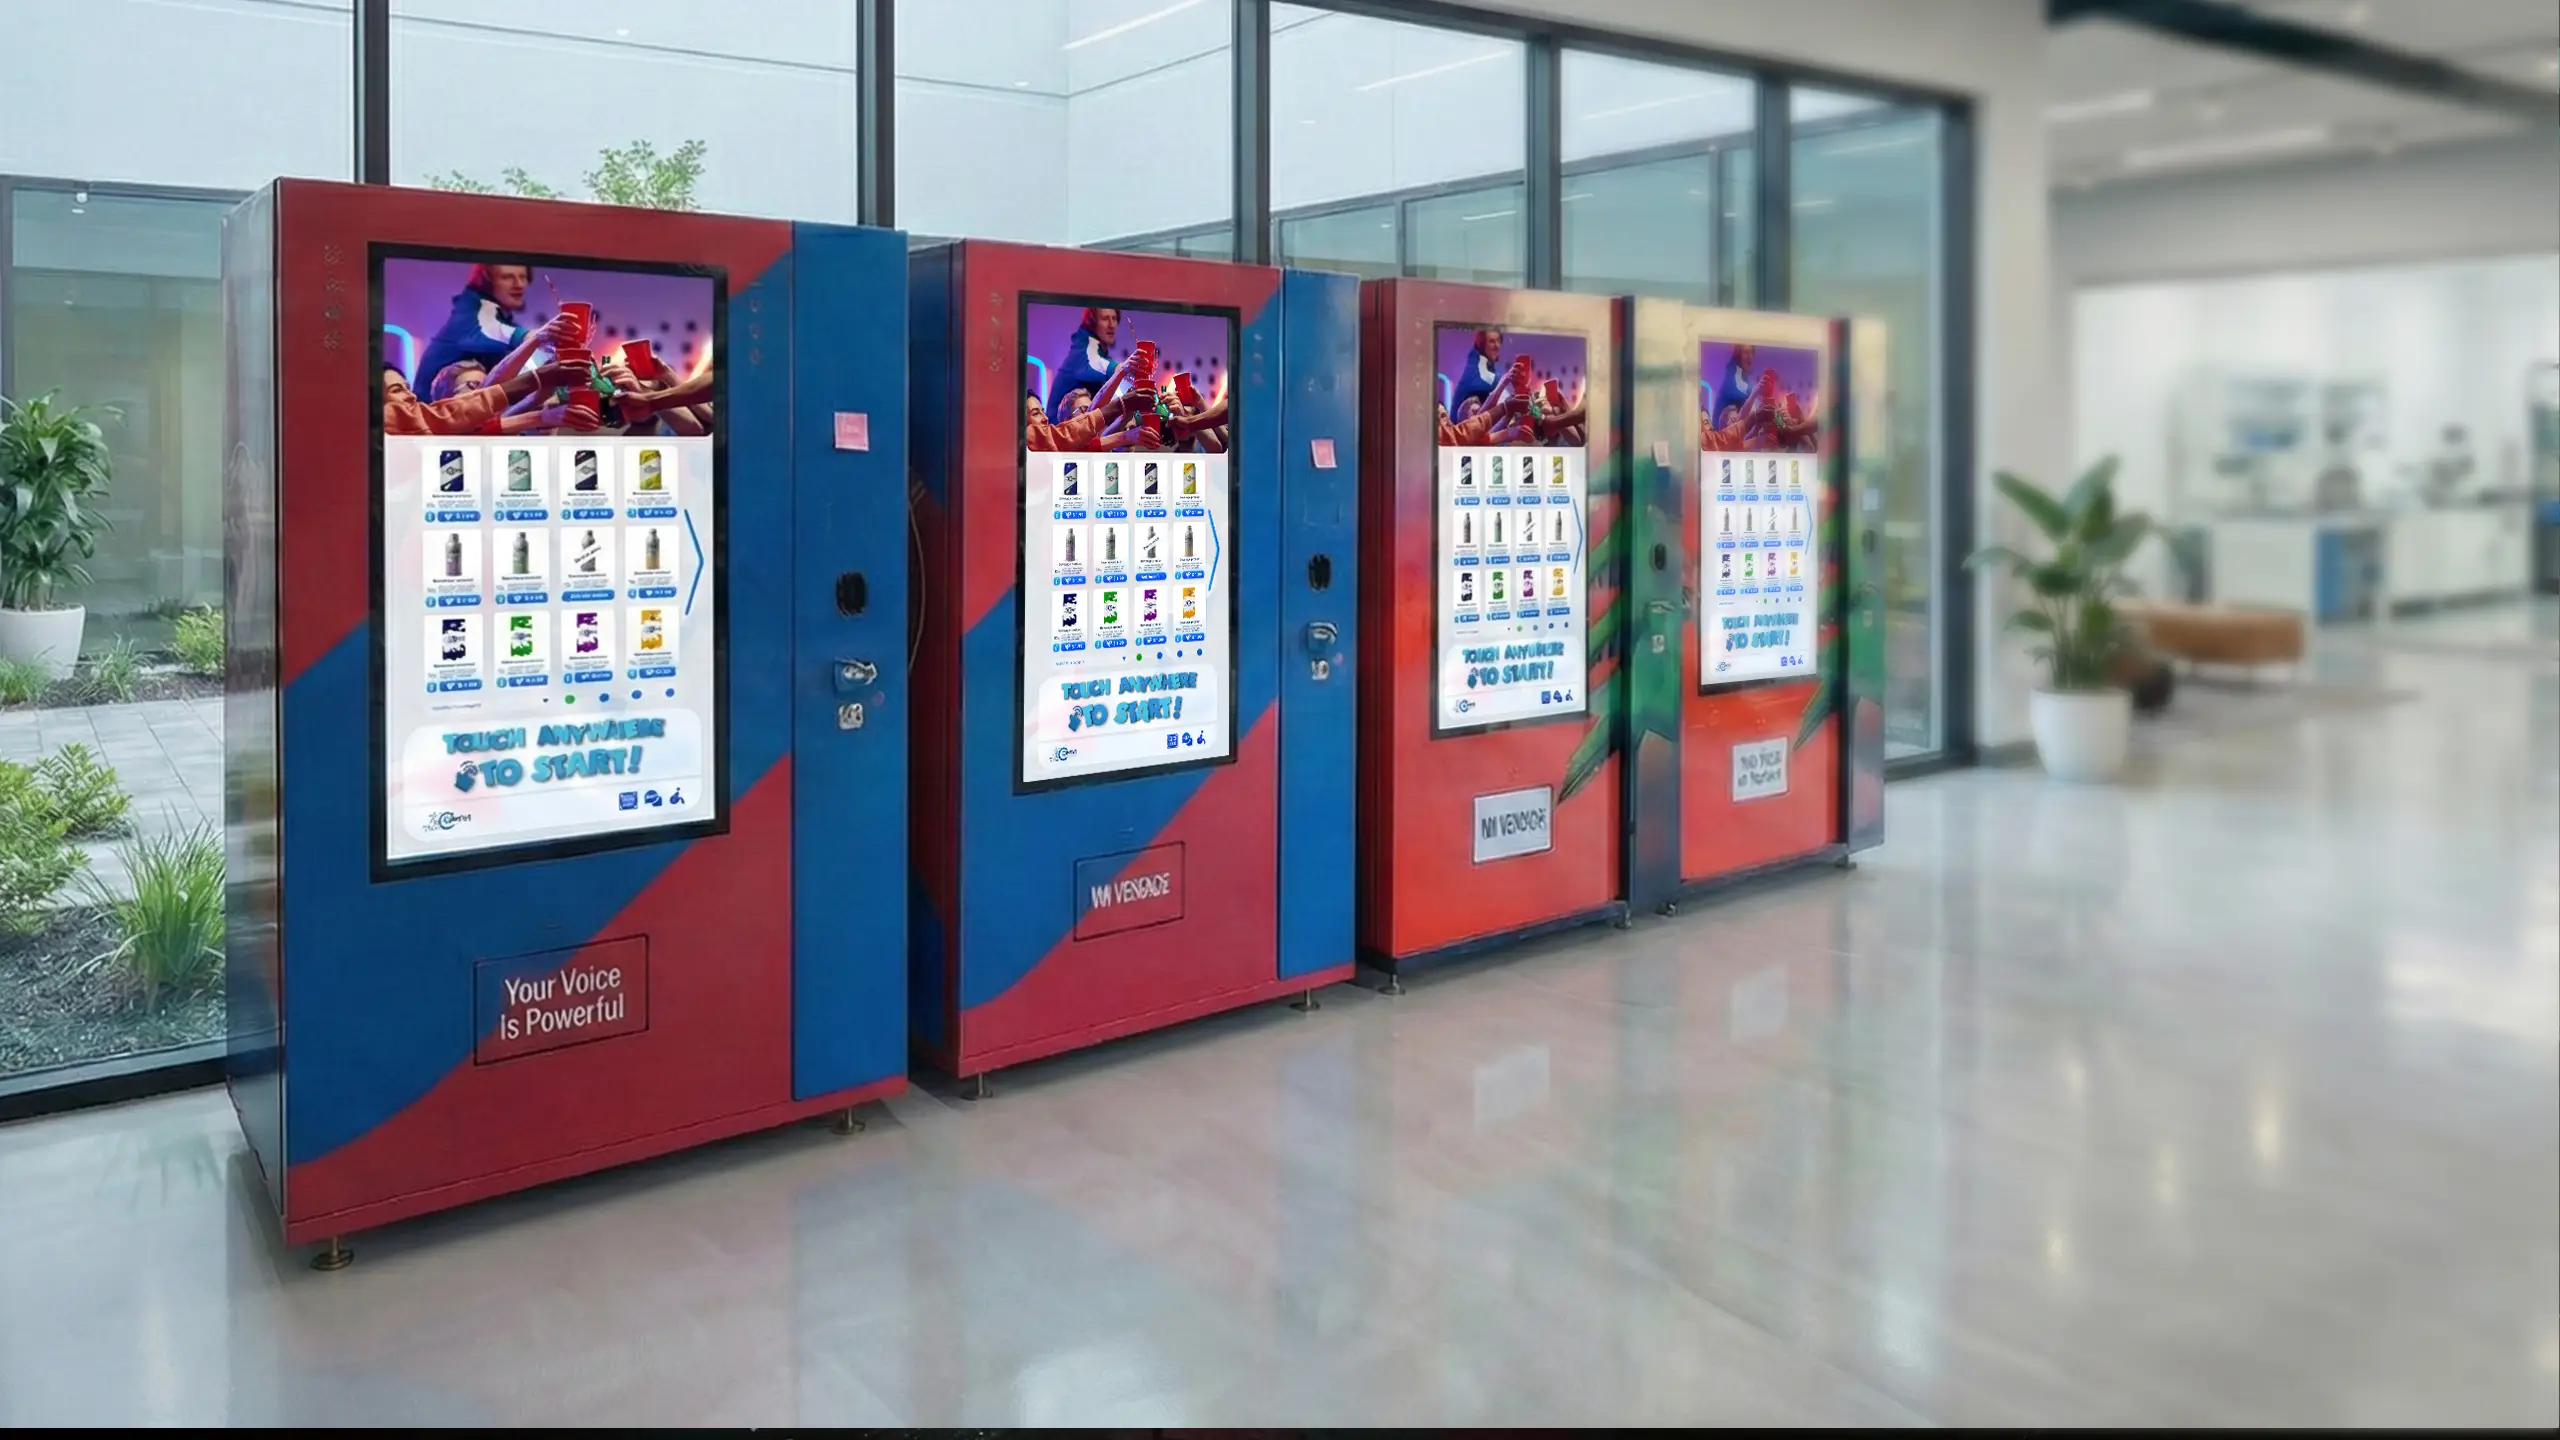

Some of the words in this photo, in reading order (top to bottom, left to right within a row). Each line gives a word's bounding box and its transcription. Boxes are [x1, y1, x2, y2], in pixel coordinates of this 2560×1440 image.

[1061, 678, 1111, 700] TOUCH
[1118, 671, 1198, 694] ANYWHERE
[1081, 703, 1109, 728] TO
[1113, 696, 1183, 725] START!
[442, 727, 526, 754] TOUCH
[478, 758, 524, 788] TO
[531, 745, 644, 783] START!
[504, 976, 557, 1006] Your
[560, 965, 621, 996] Voice
[500, 1013, 520, 1041] Is
[525, 992, 624, 1036] Powerful
